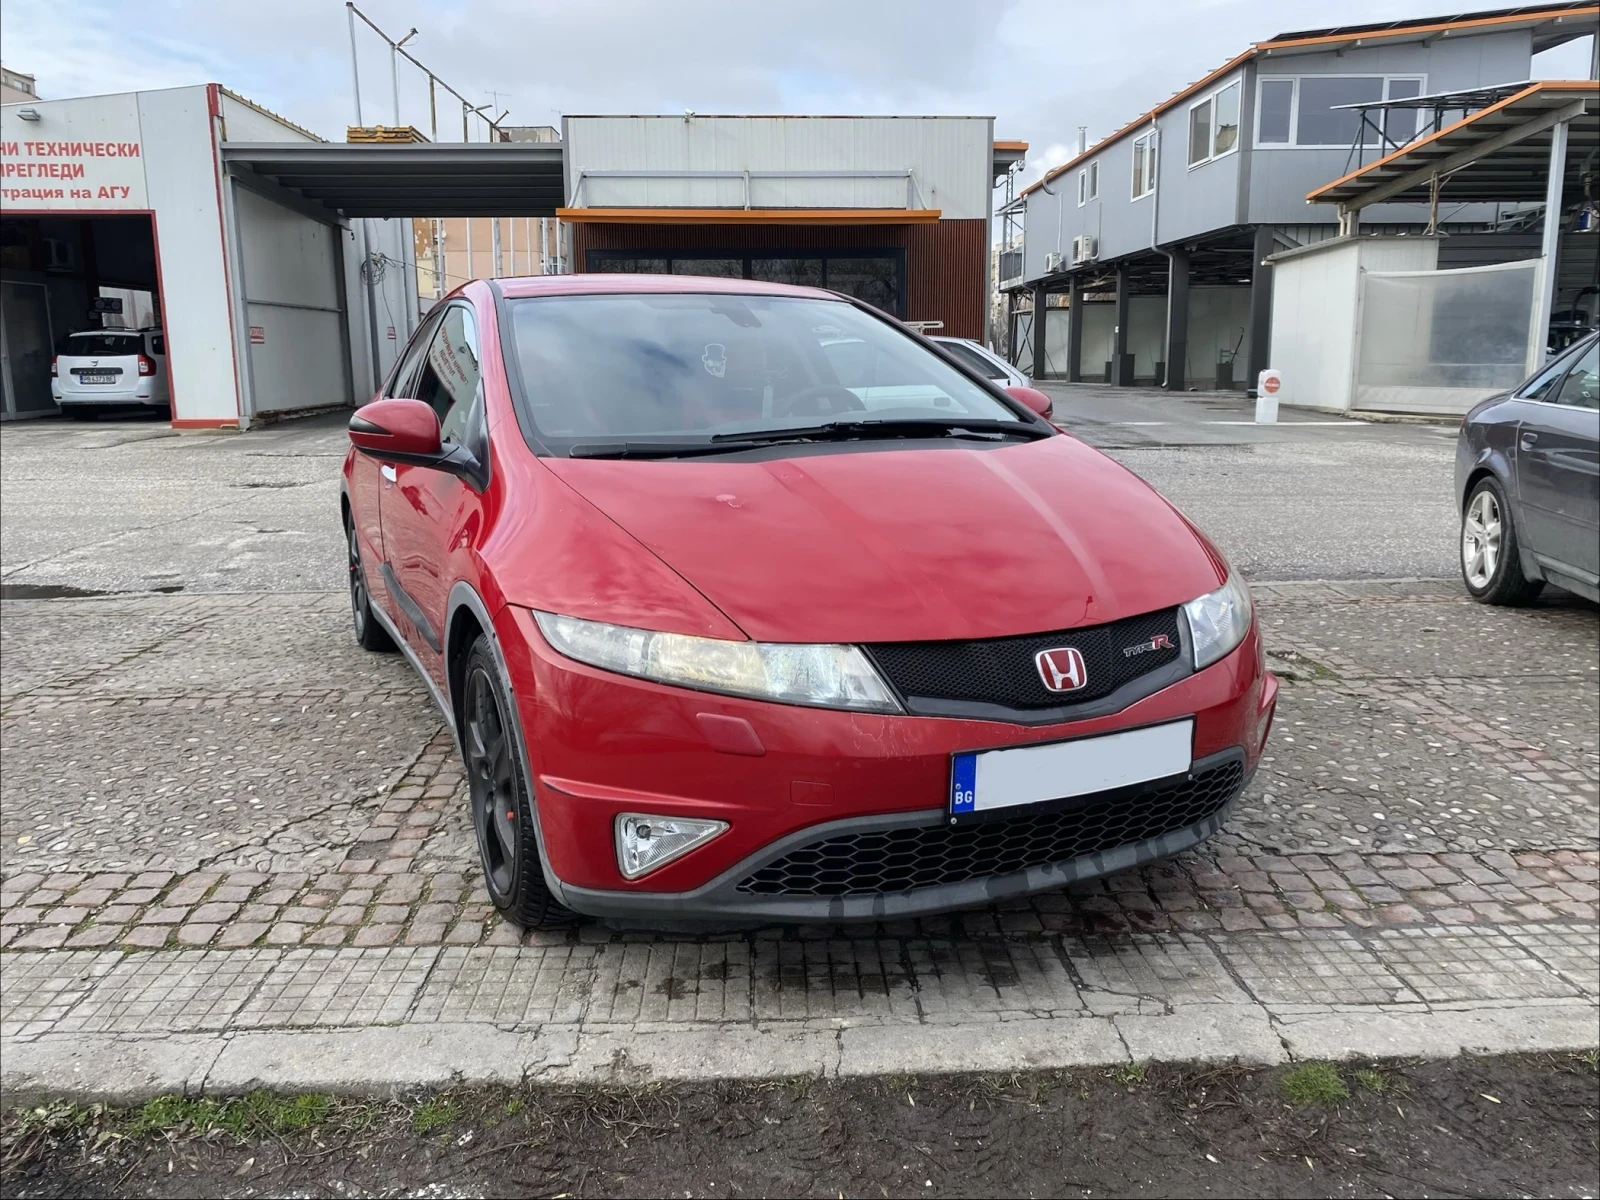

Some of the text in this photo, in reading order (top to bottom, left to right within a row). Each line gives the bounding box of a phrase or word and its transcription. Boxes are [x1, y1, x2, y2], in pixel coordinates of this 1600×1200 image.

[24, 142, 140, 157] ТЕХНИЧЕСКИ
[70, 189, 92, 199] на
[97, 186, 131, 199] АГУ
[1151, 634, 1175, 649] R
[955, 790, 973, 804] BG
